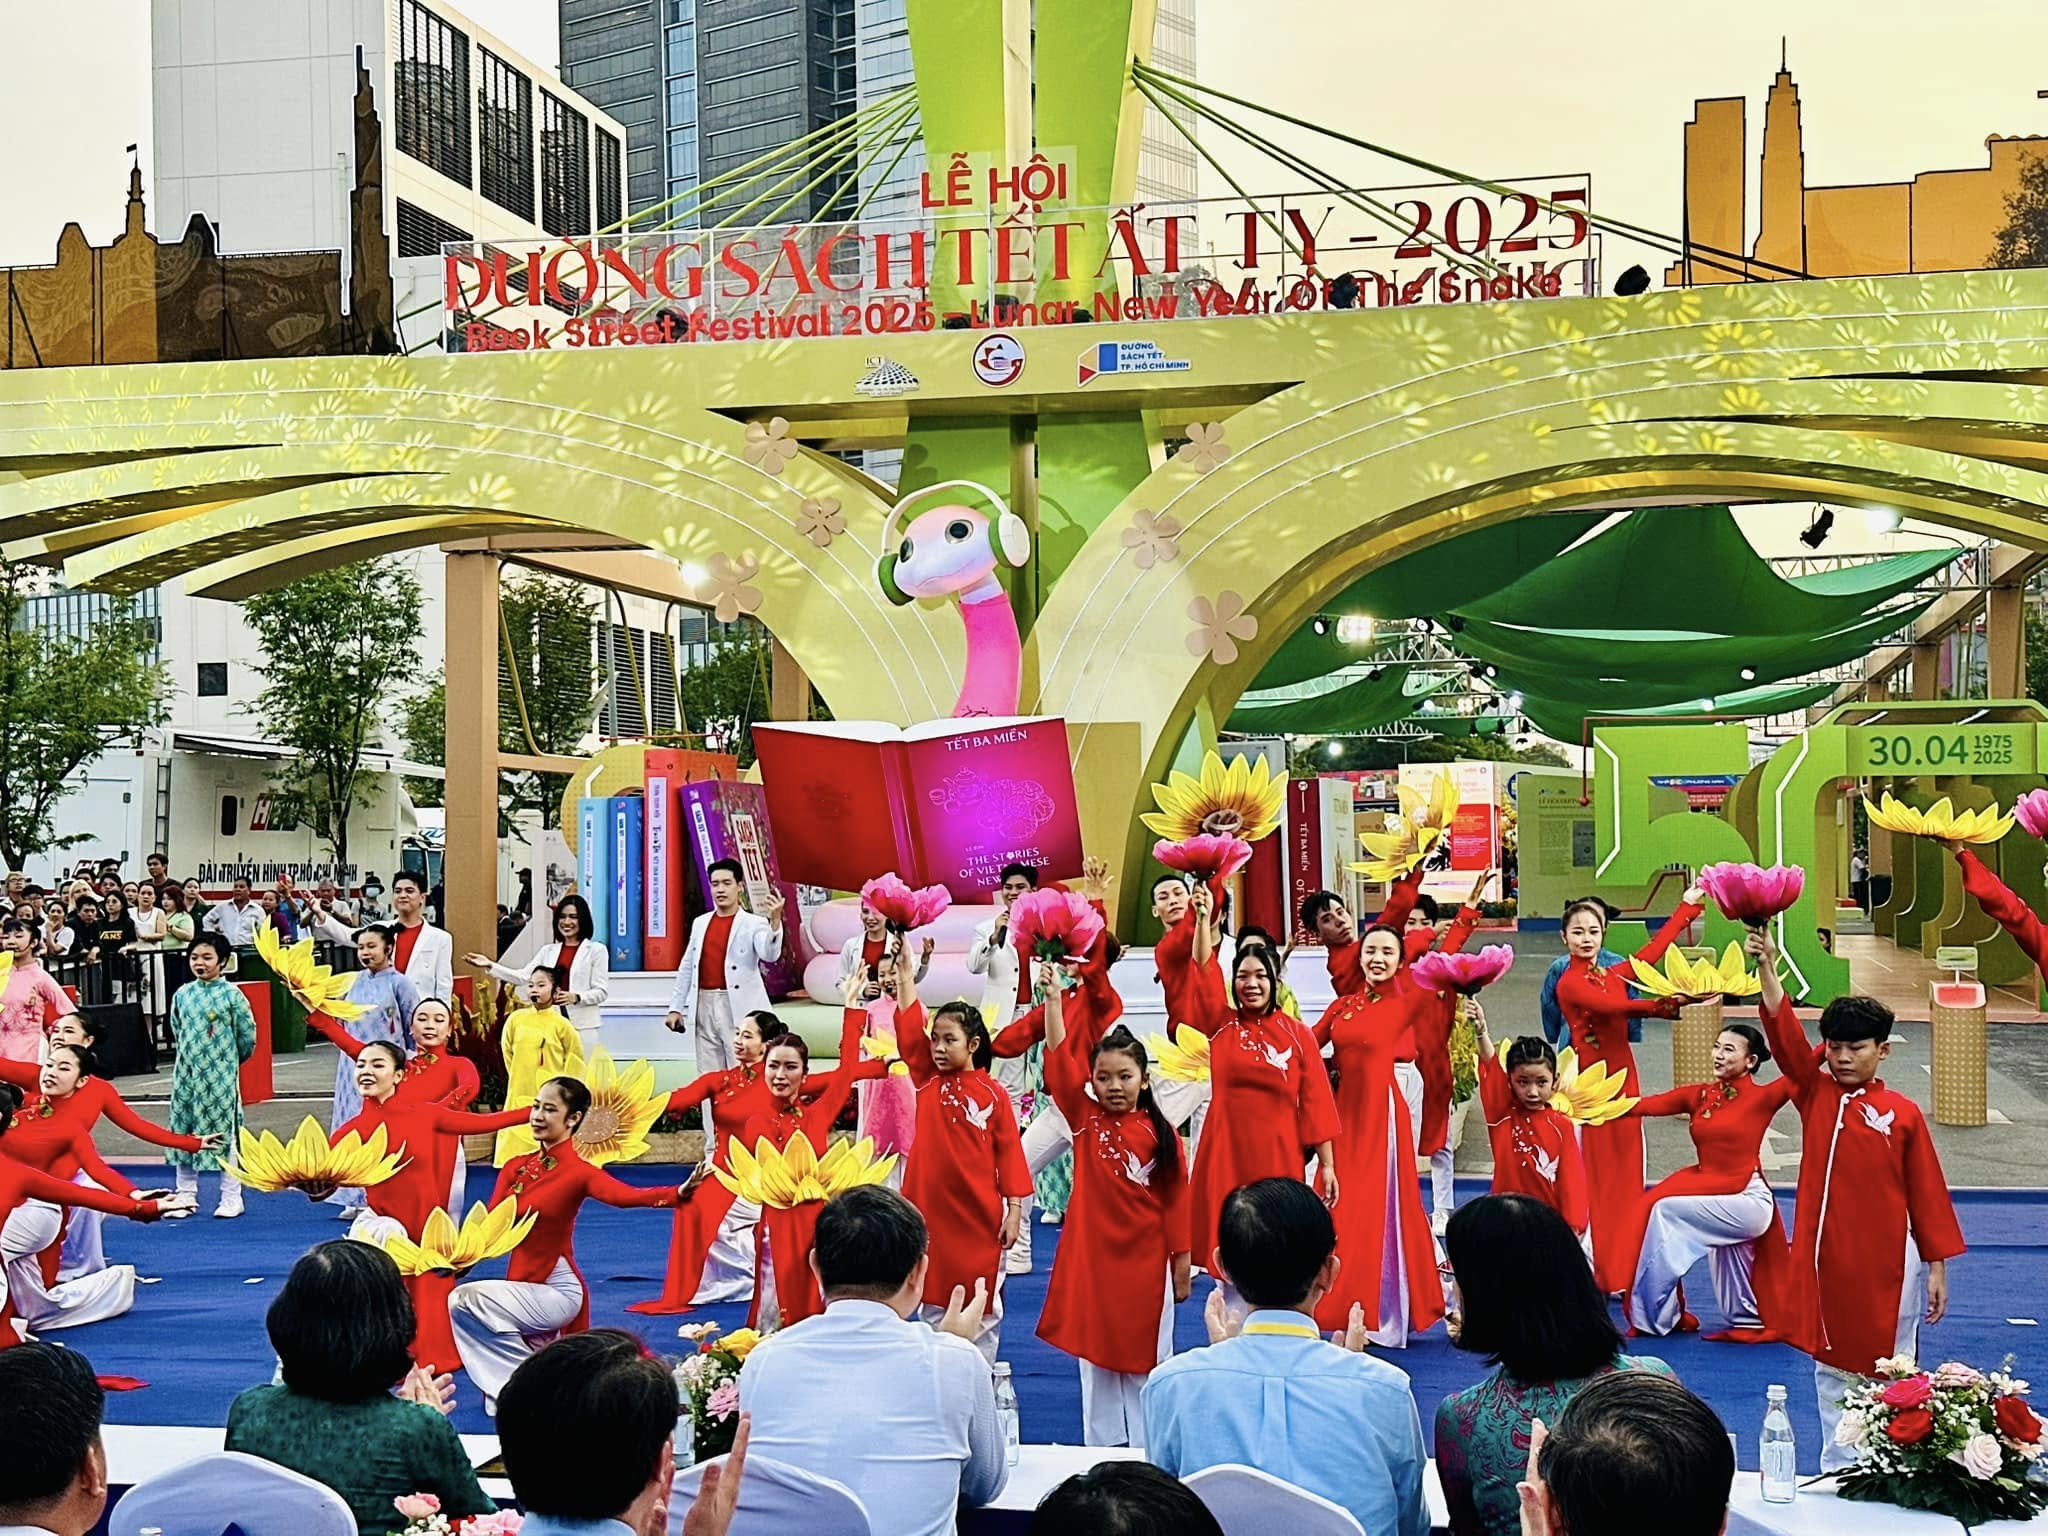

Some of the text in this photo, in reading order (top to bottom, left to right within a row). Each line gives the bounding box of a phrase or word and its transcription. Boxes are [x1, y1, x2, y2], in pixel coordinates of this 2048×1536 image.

[921, 152, 1066, 213] LỄ HỘI
[444, 236, 704, 310] ĐƯỜNG
[721, 225, 930, 298] SÁCH
[941, 202, 1085, 286] TẾT
[1094, 202, 1196, 278] ẤT
[1393, 187, 1588, 260] 2025
[467, 319, 551, 352] Book
[564, 314, 676, 347] Street
[689, 304, 832, 342] Festival
[842, 302, 937, 336] 2025
[971, 299, 1079, 330] Lunar
[1093, 291, 1178, 323] New
[1194, 284, 1277, 318] Year
[1439, 266, 1562, 304] Snake
[945, 736, 970, 752] TẾT
[973, 736, 991, 748] BA
[1869, 735, 2013, 766] 30.04 1975
[1973, 750, 2013, 764] 2025
[968, 854, 990, 867] THE
[959, 868, 975, 879] OF
[1296, 878, 1304, 893] OF
[100, 930, 123, 940] VANS
